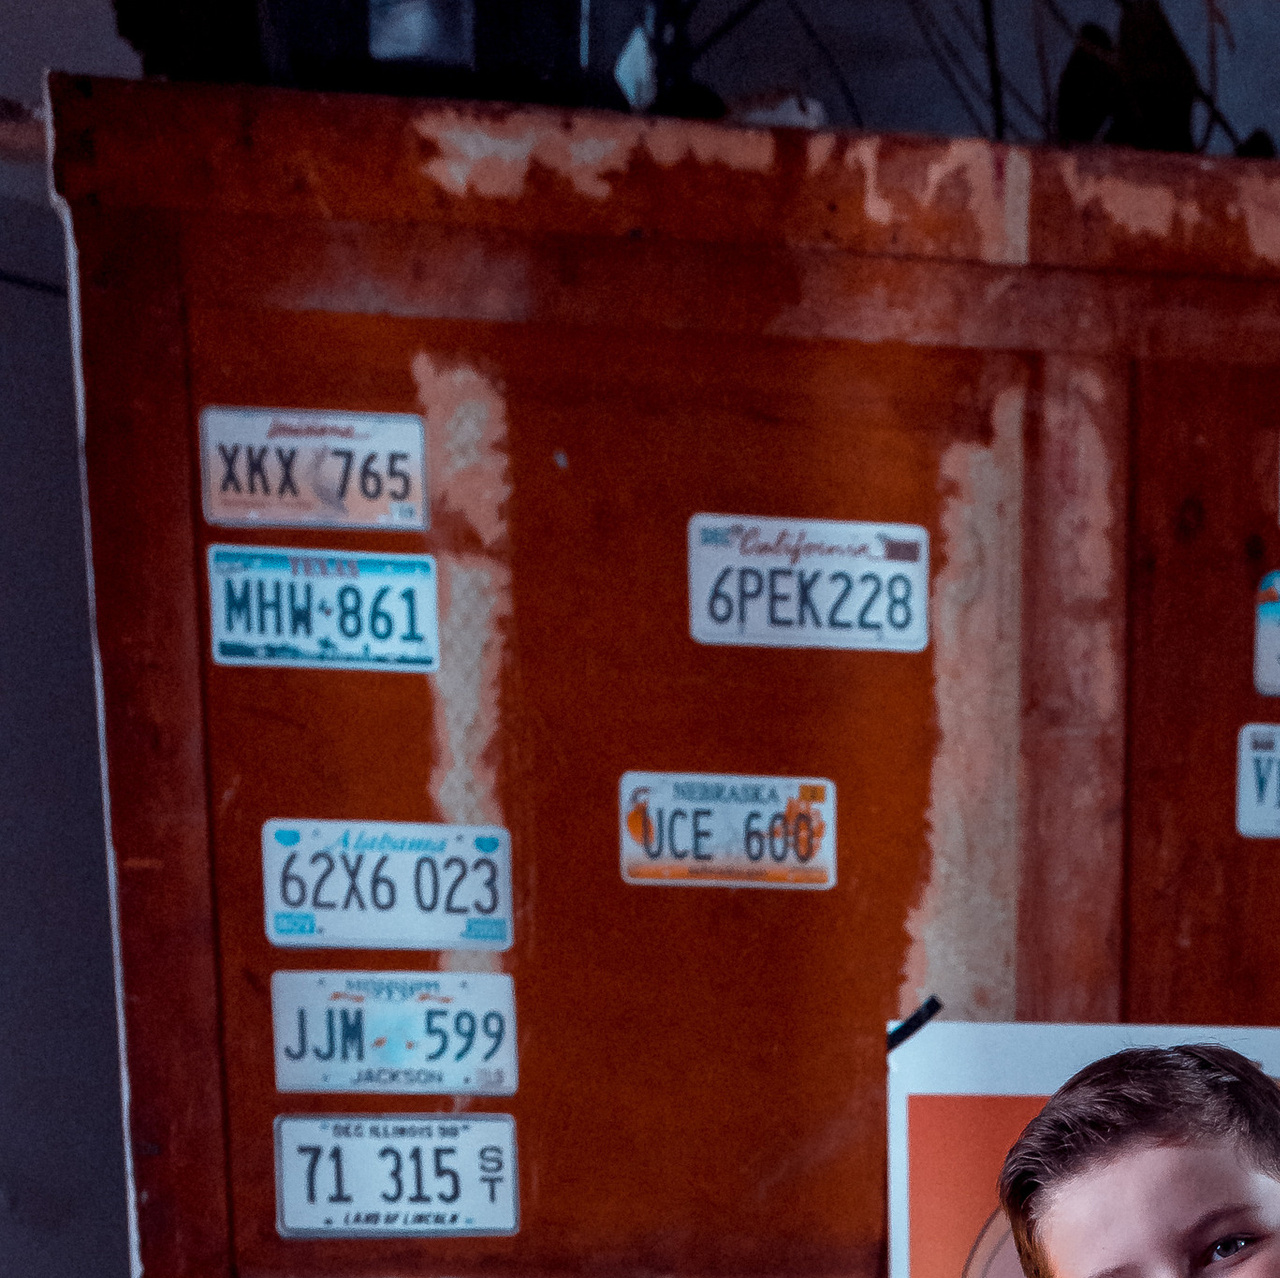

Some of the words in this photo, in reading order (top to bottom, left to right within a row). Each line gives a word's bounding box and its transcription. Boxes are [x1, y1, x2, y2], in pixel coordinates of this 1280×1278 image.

[218, 443, 299, 498] XKX
[332, 450, 411, 501] 765
[736, 526, 871, 564] California
[707, 564, 914, 631] 6PEK228
[673, 781, 780, 804] NEBRASKA
[642, 805, 713, 861] UCE
[744, 811, 816, 863] 600
[279, 850, 397, 911] 62X6
[414, 856, 499, 914] 023
[284, 1009, 365, 1061] JJM
[425, 1009, 506, 1062] 599
[351, 1068, 443, 1085] JACKSON
[298, 1146, 352, 1204] 71
[379, 1146, 460, 1204] 315
